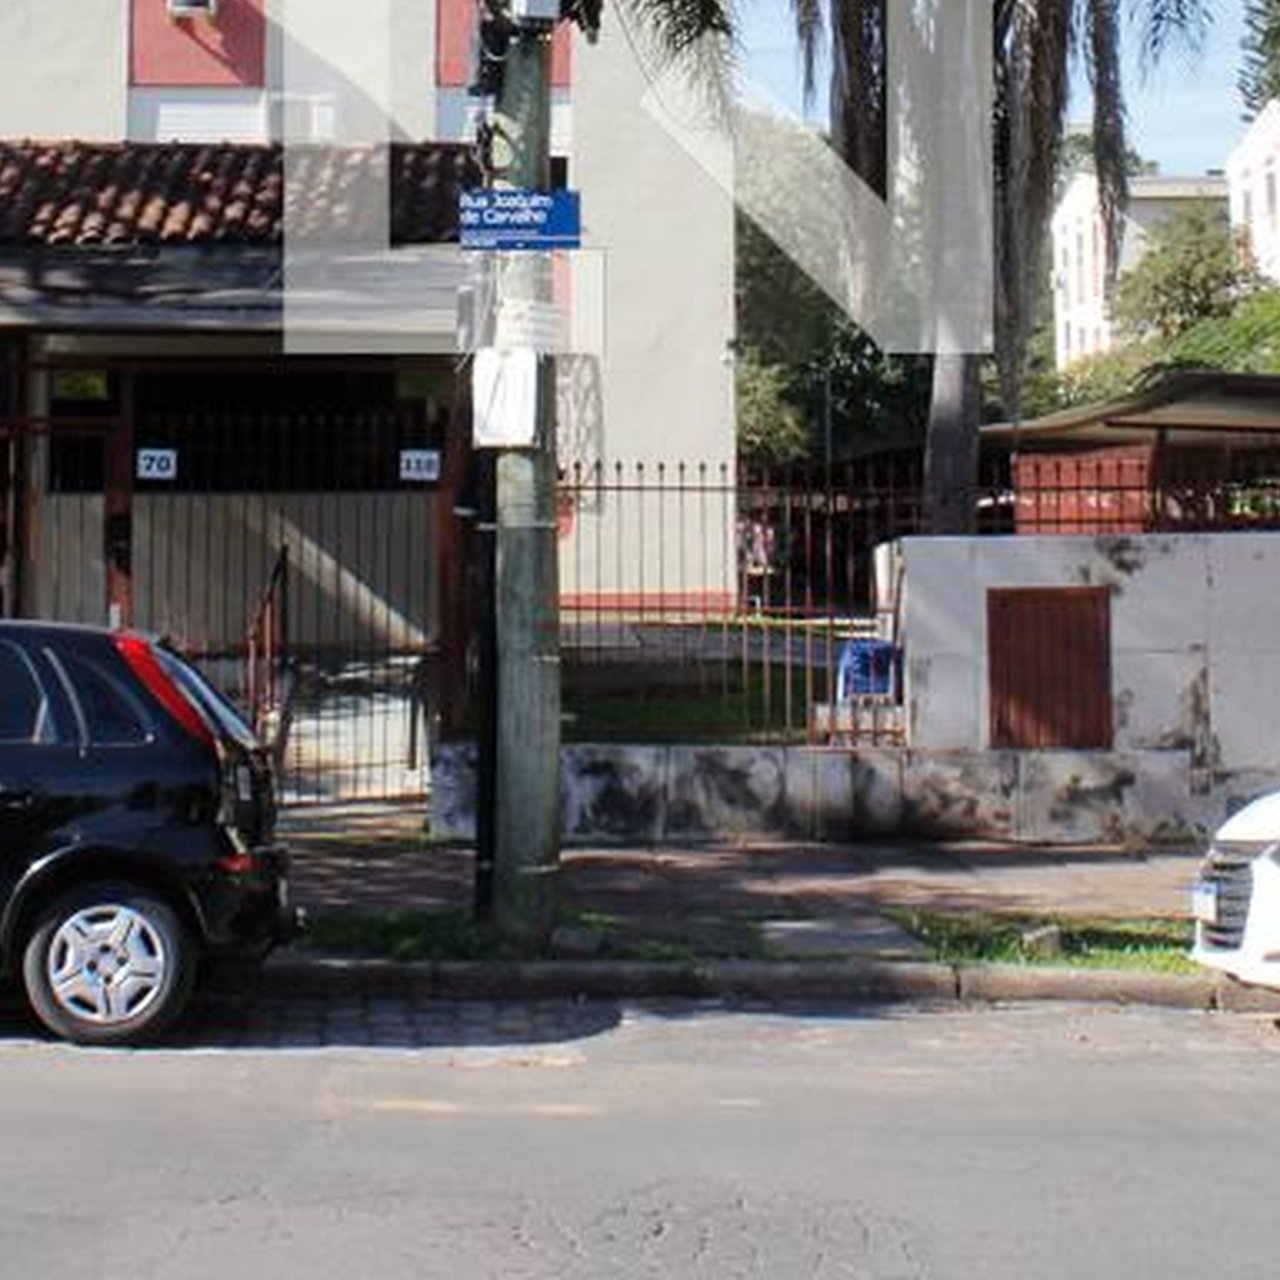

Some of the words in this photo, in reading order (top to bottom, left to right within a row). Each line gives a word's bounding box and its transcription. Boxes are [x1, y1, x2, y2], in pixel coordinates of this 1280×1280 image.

[460, 193, 488, 208] Rua
[494, 193, 553, 209] Joaquim
[460, 209, 480, 224] de
[483, 208, 547, 224] Carvalho
[142, 455, 171, 471] 70
